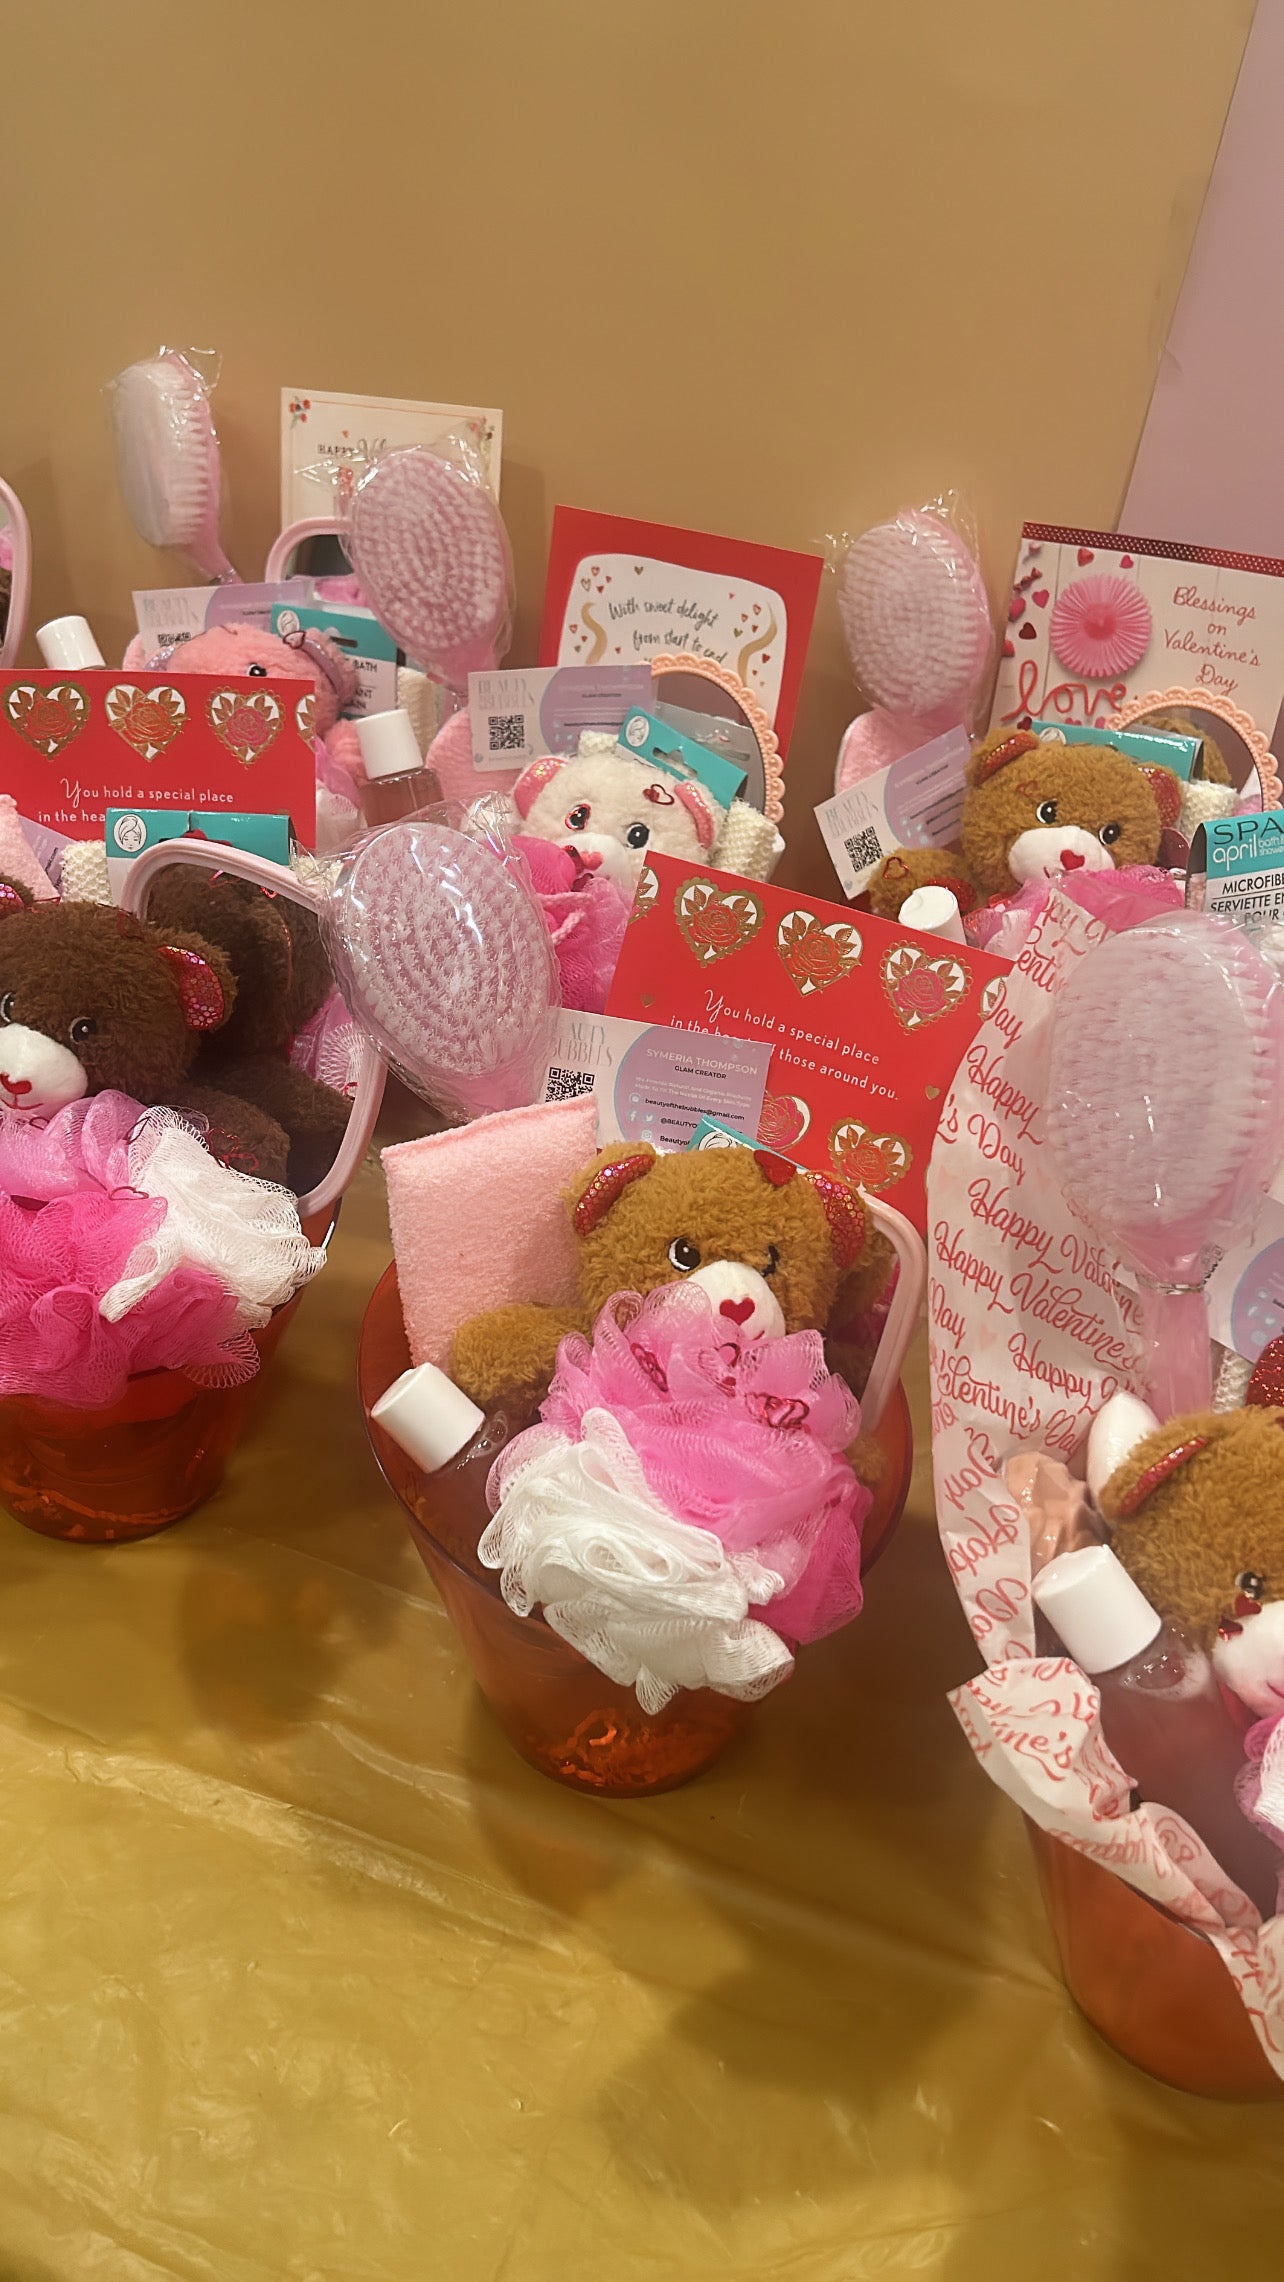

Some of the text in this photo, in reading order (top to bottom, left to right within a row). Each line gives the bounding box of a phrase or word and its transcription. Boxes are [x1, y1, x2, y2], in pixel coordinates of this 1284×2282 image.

[608, 597, 719, 632] With sweet delight
[1173, 586, 1257, 625] Blessings
[632, 629, 661, 651] from
[664, 629, 690, 648] start
[691, 632, 704, 653] to
[1207, 623, 1228, 636] on
[1164, 629, 1262, 667] Valentine's
[1001, 659, 1128, 722] love
[1195, 663, 1239, 695] Day
[60, 778, 234, 809] You hold a special place
[38, 811, 106, 823] in the hea
[1213, 816, 1284, 845] SPA
[1212, 833, 1258, 872] april
[1210, 894, 1271, 913] SERVIETTE
[670, 1015, 683, 1029] in
[687, 1020, 709, 1035] the
[704, 988, 740, 1023] You
[743, 1010, 775, 1030] hold
[778, 1023, 786, 1033] a
[789, 1025, 840, 1052] special
[841, 1042, 881, 1066] place
[646, 1048, 759, 1075] SYMERIA THOMPSON
[674, 1065, 727, 1079] GLAM CREATOR
[779, 1049, 816, 1071] those
[819, 1064, 869, 1089] around
[871, 1083, 900, 1101] you.
[967, 1045, 1043, 1145] Happy
[660, 1117, 697, 1129] @BEAUTYO
[967, 1113, 1026, 1186] Day
[967, 1178, 1064, 1275] Happy
[933, 1220, 1015, 1314] Happy
[1007, 1333, 1098, 1416] Happy
